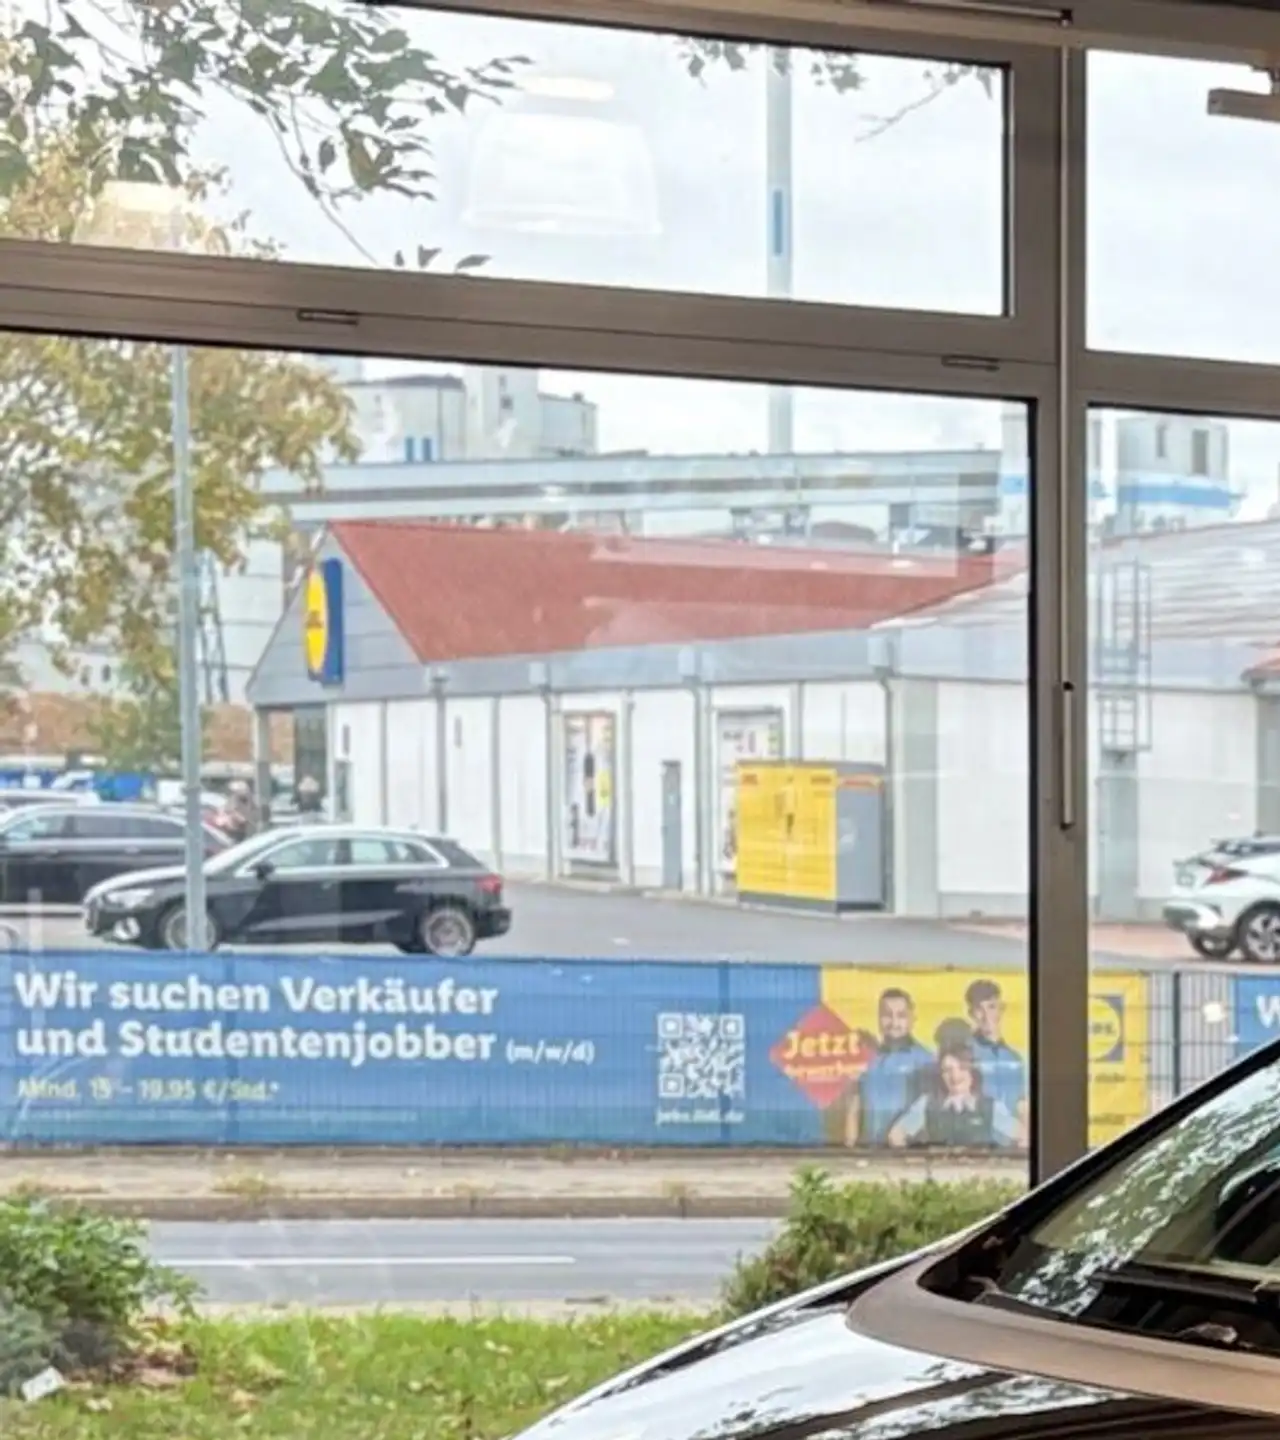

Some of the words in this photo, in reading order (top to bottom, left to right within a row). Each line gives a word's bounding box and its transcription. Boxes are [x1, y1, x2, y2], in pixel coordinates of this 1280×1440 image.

[13, 970, 98, 1010] Wir
[108, 974, 270, 1012] suchen
[279, 976, 498, 1015] Verkäufer
[16, 1018, 108, 1056] und
[118, 1019, 498, 1067] Studentenjobber
[505, 1038, 596, 1065] (m/w/d)
[783, 1030, 861, 1060] Jetzt
